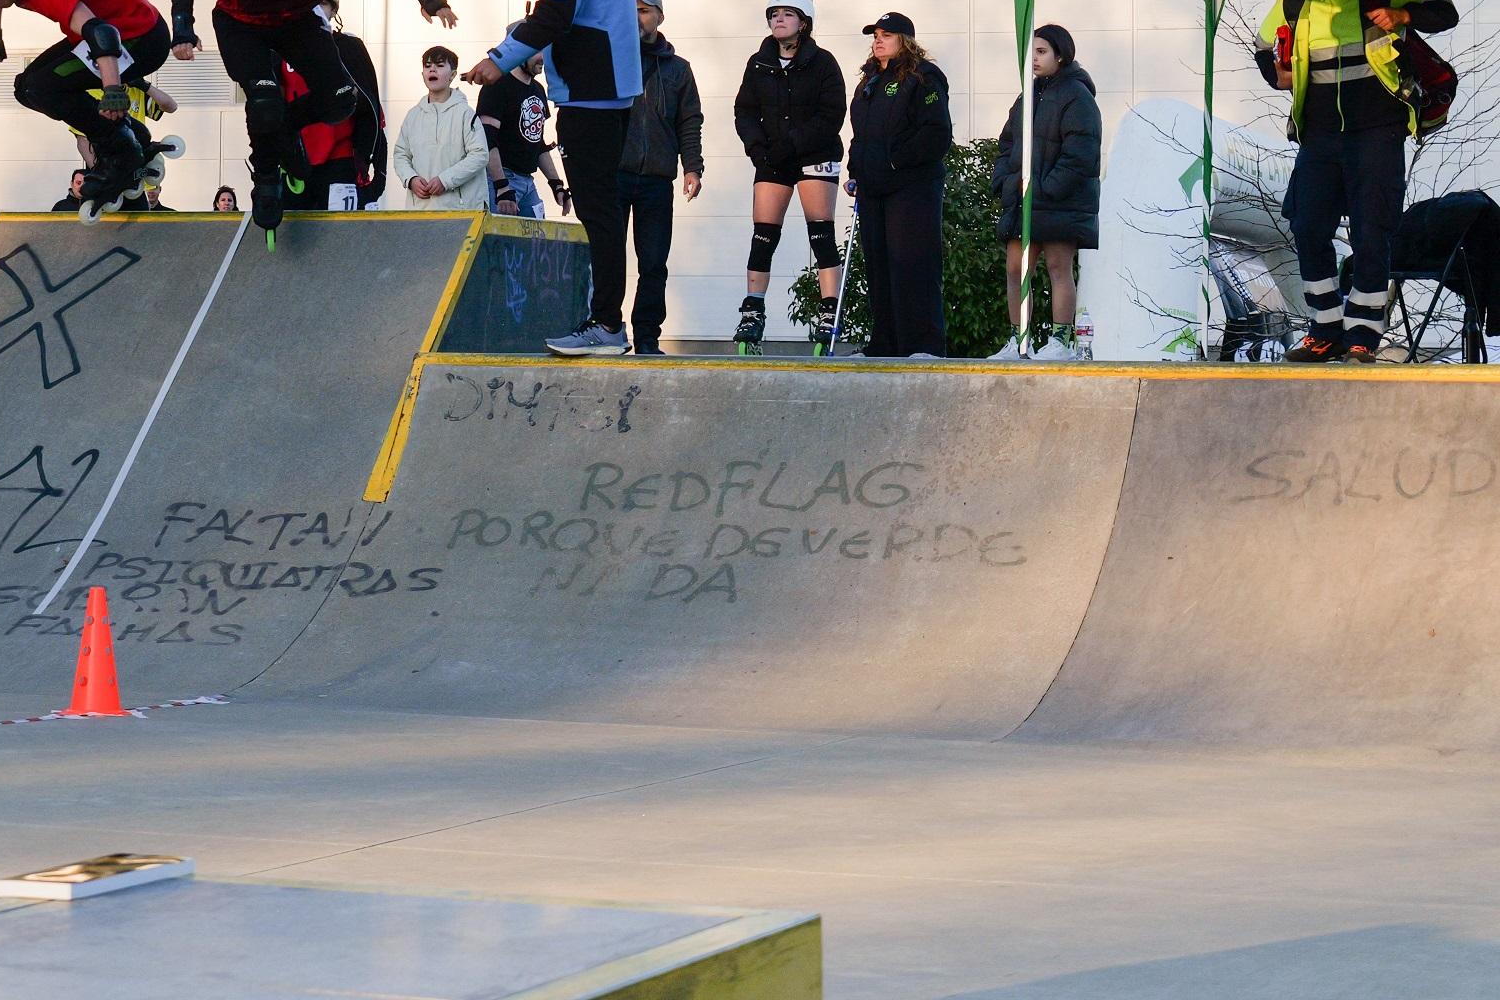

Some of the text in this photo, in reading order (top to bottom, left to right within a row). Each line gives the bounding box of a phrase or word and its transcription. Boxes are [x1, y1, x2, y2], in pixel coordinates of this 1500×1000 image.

[154, 501, 393, 551] FALTAN
[446, 507, 680, 560] PORQUE
[85, 552, 445, 598] PSIQUIATRAS
[4, 614, 246, 646] FAHAS
